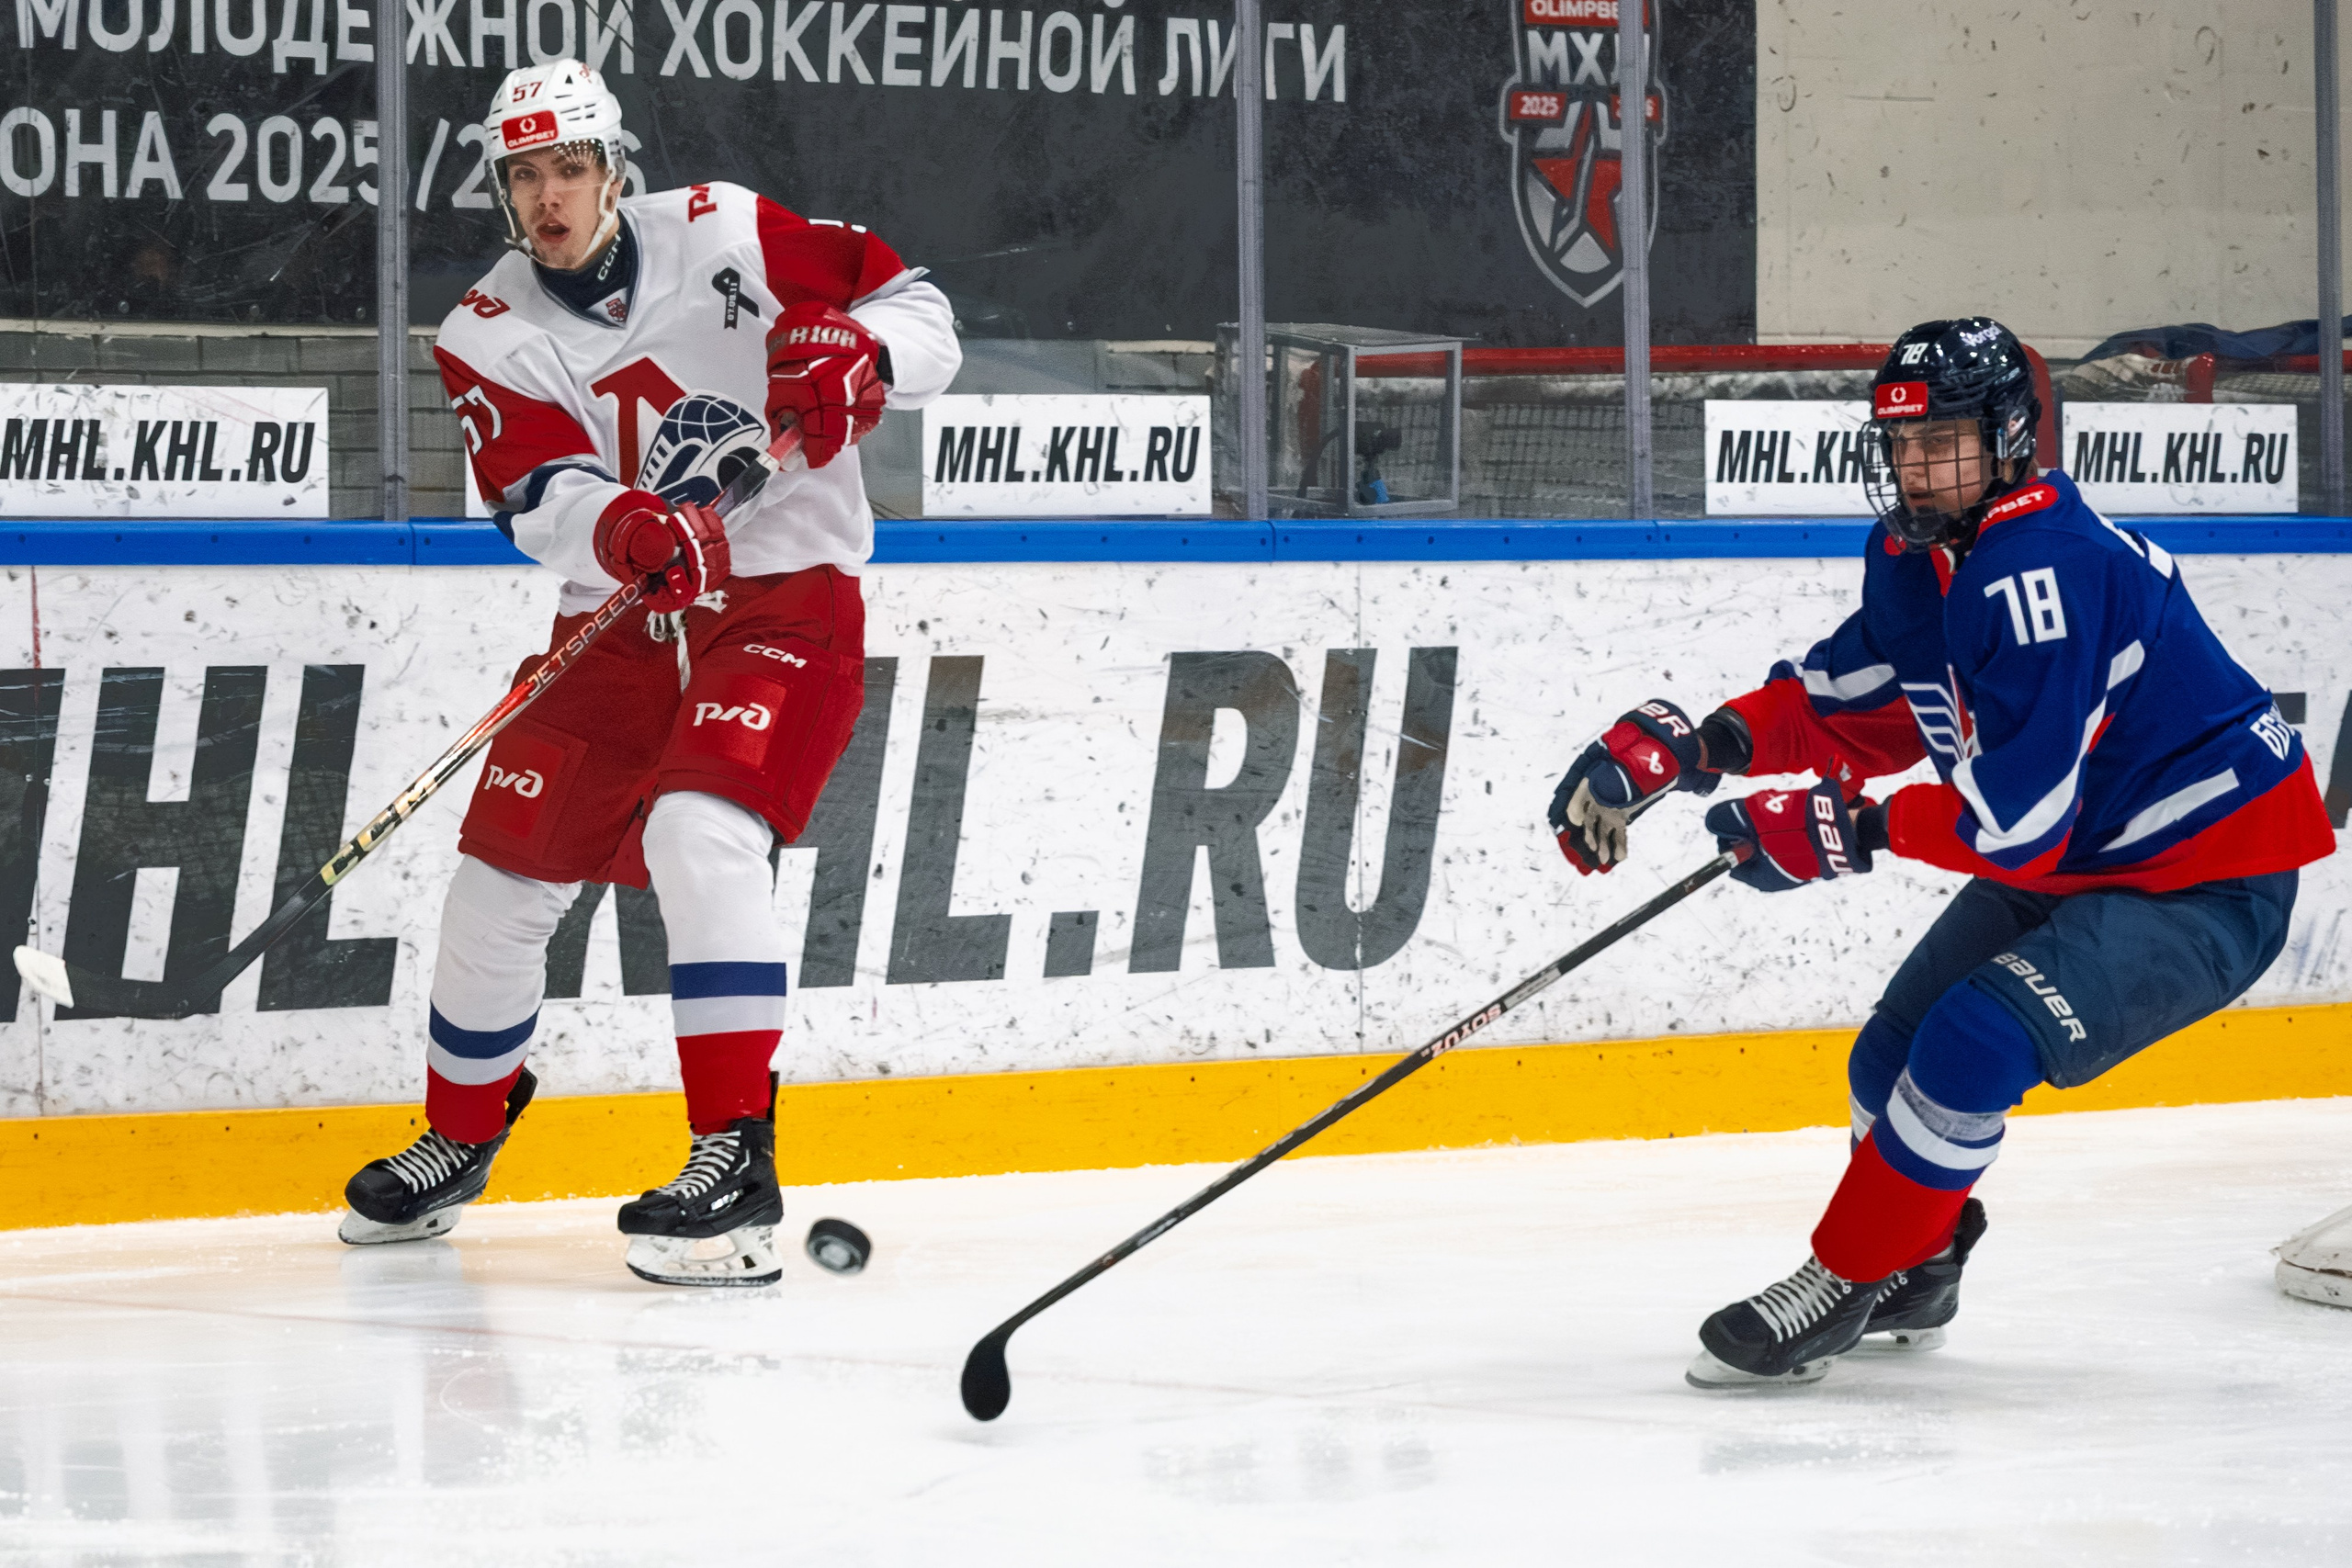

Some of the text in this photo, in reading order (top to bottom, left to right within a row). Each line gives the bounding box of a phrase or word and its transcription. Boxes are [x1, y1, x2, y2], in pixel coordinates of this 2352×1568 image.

[659, 0, 1136, 96] ХОККЕЙНОЙ
[1158, 17, 1346, 103] ЛИГИ
[512, 81, 543, 103] 57
[1520, 95, 1559, 117] 2025
[0, 106, 184, 200] ОНА
[507, 130, 556, 148] OLIMPBET
[598, 233, 621, 281] CCM
[1900, 343, 1929, 365] 78
[0, 418, 316, 483] MHL.KHL.RU
[934, 425, 1201, 483] MHL.KHL.RU
[2073, 431, 2289, 484] MHL.KHL.RU
[1984, 567, 2067, 646] 78
[526, 583, 639, 698] JETSPEED
[742, 643, 808, 669] CCM
[1431, 1003, 1502, 1058] SOYUZ
